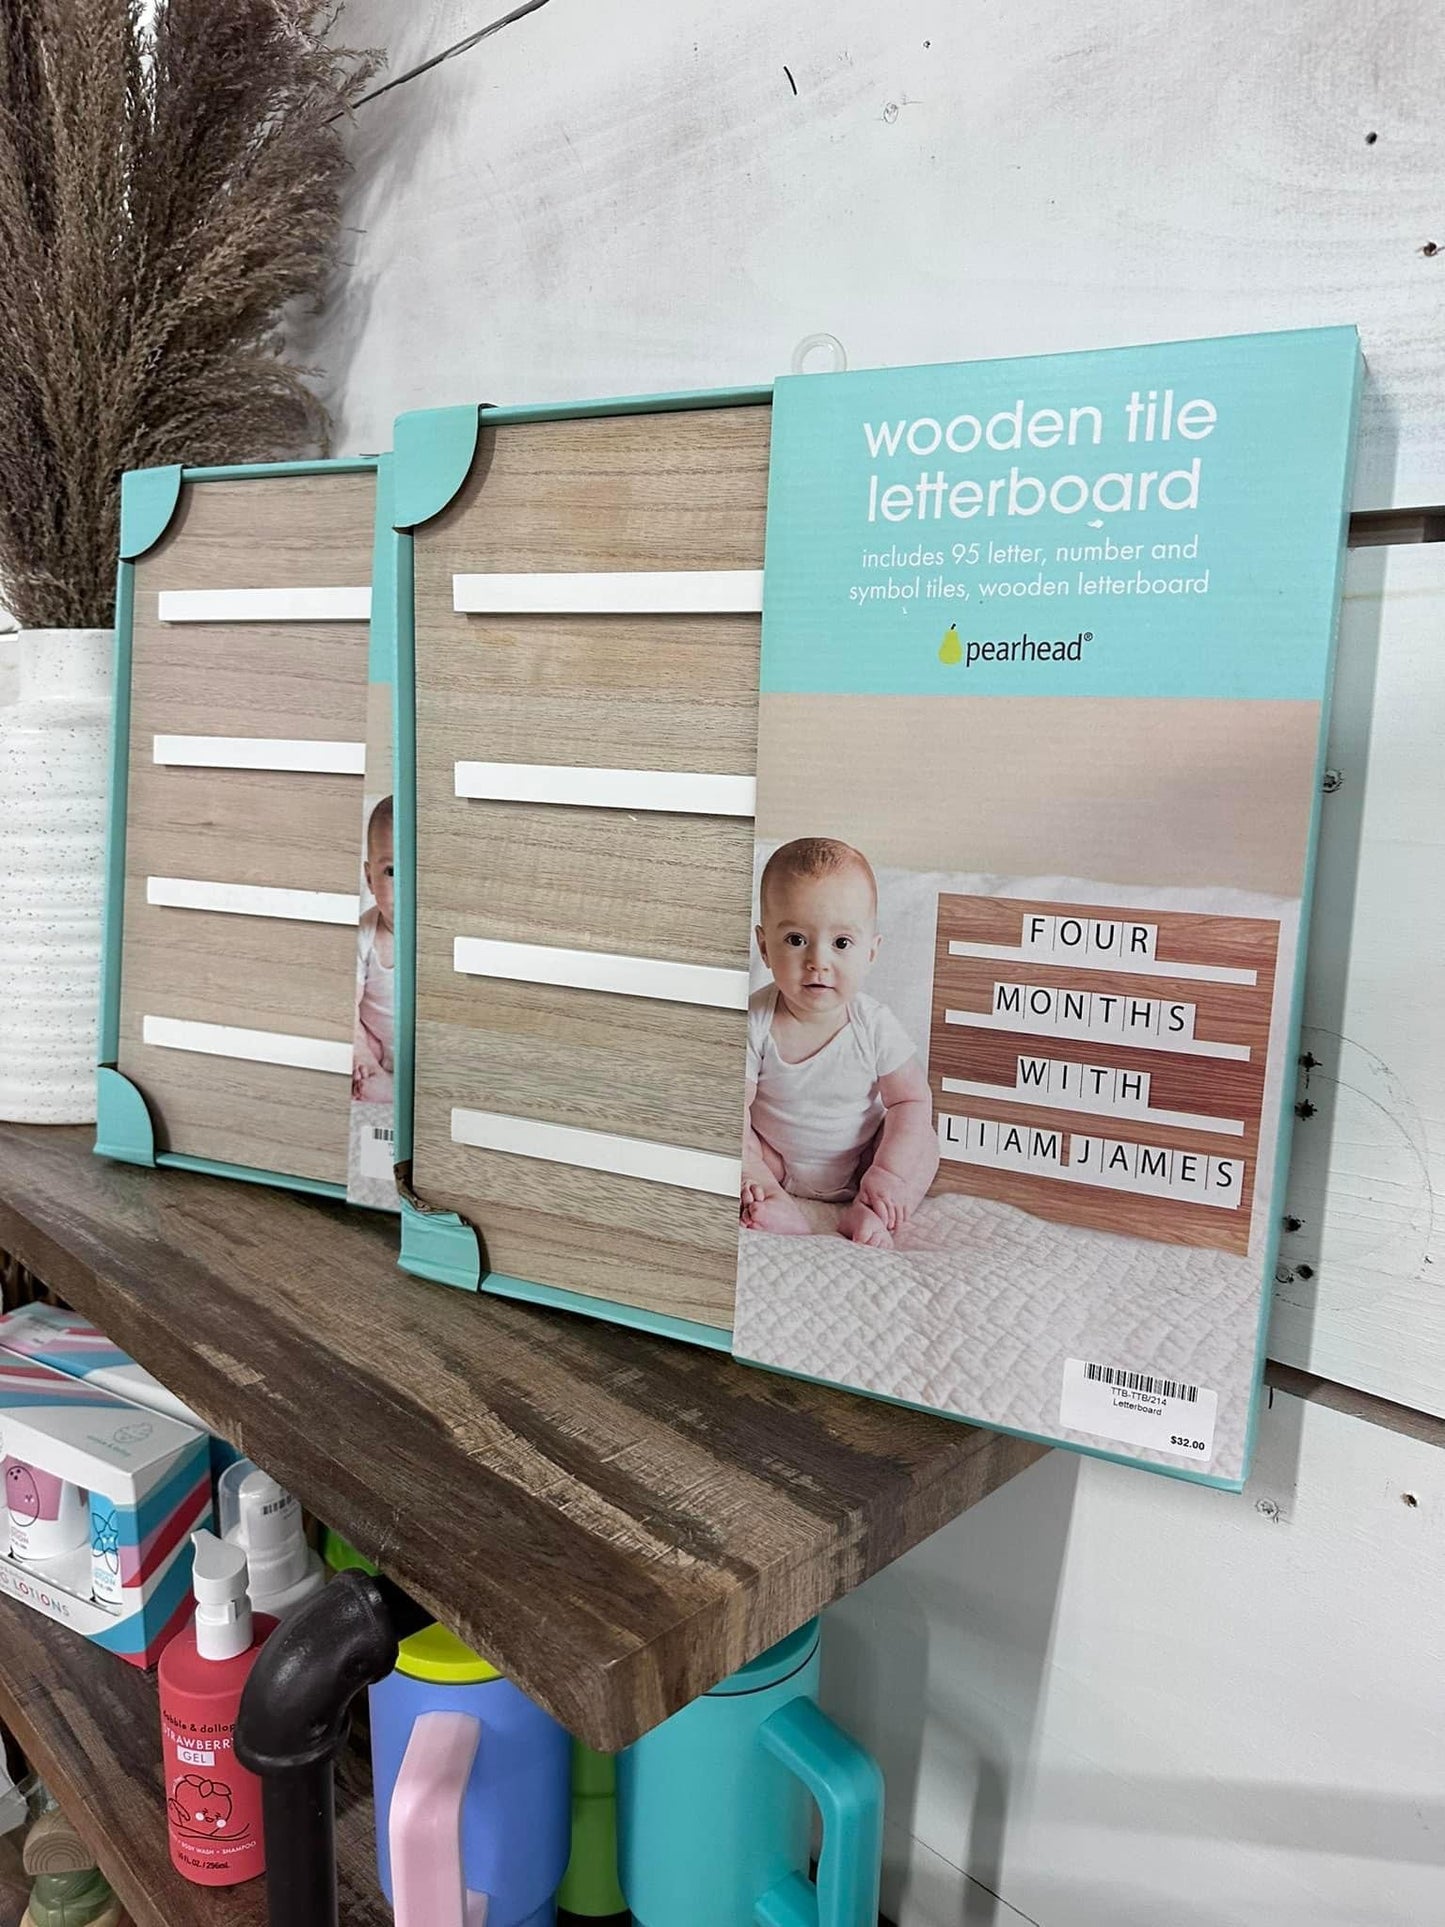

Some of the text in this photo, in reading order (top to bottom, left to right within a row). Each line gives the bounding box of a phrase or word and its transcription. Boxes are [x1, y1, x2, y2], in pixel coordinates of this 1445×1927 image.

[863, 389, 1218, 458] wooden tile
[866, 458, 1202, 523] letterboard
[862, 535, 1198, 568] includes 95 letter, number and
[849, 570, 1209, 606] symbol tiles, wooden letterboard
[1029, 917, 1149, 954] FOUR
[996, 985, 1185, 1032] MONTHS
[1019, 1058, 1142, 1100] WITH
[946, 1117, 1233, 1188] LIAM JAMES
[1113, 1399, 1162, 1416] Letterboard
[1170, 1435, 1205, 1450] $32.00
[13, 1579, 70, 1617] LOTIONS
[190, 1724, 197, 1732] &
[183, 1751, 207, 1763] GEL
[222, 1841, 256, 1854] SHAMPOO
